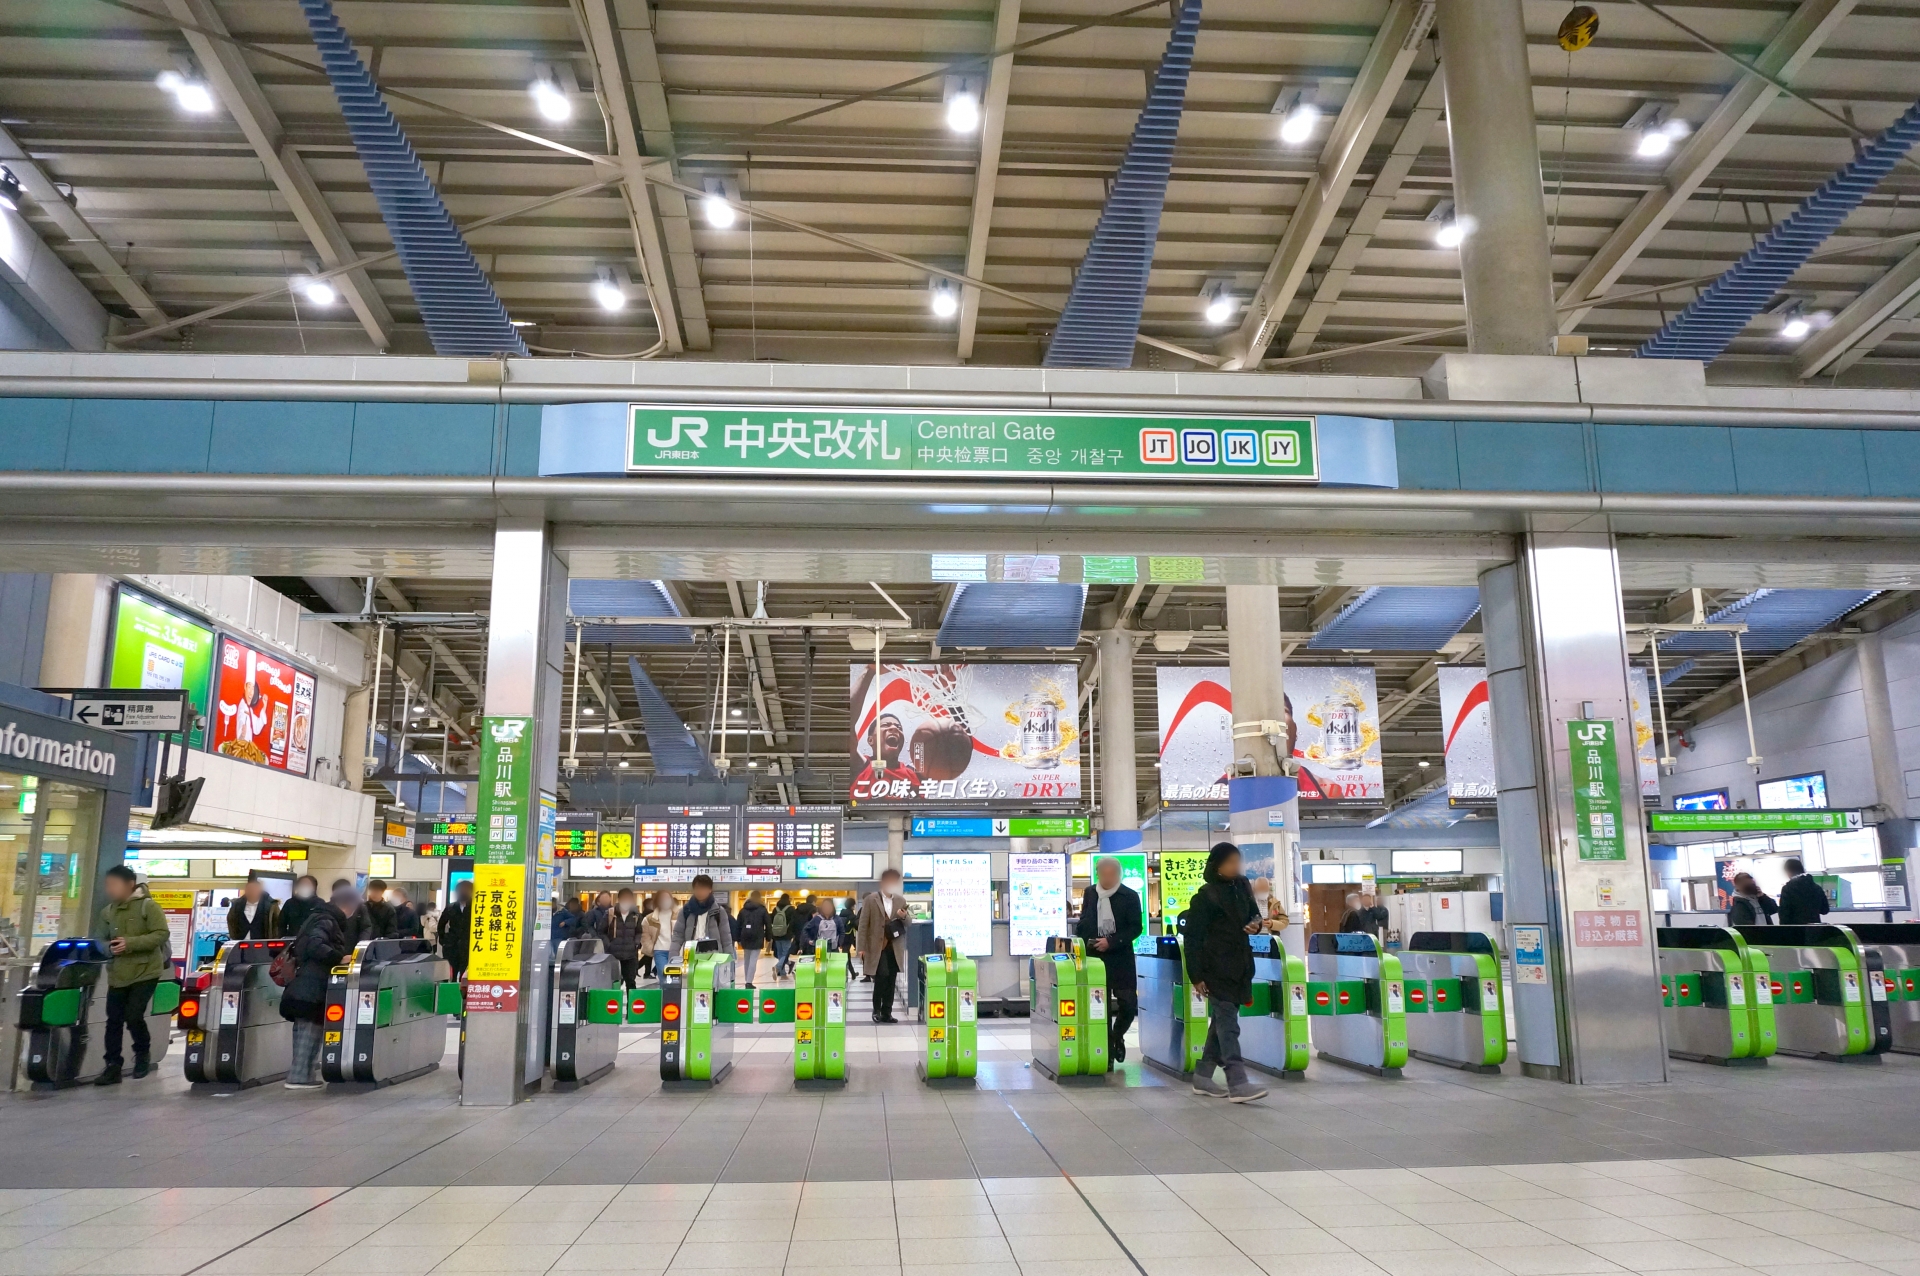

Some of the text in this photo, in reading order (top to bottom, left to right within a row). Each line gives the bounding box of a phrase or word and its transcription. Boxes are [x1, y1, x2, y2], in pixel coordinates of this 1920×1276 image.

[647, 416, 709, 448] JR
[724, 418, 901, 460] 中央改札
[917, 420, 1056, 441] Central Gate
[654, 450, 700, 460] JR東日本
[917, 445, 1008, 464] 中央检票口
[1149, 438, 1291, 456] JT JO JK JY
[1026, 447, 1124, 466] 중앙 개찰구
[127, 705, 154, 713] 精算機
[491, 720, 523, 738] JR
[1023, 719, 1056, 733] Asahi
[1326, 720, 1357, 734] Asahi
[1577, 724, 1607, 741] JR
[494, 746, 513, 798] 品川駅
[1587, 749, 1606, 797] 品川駅
[914, 820, 925, 834] 4
[1075, 820, 1085, 834] 3
[1836, 814, 1843, 828] 1
[472, 890, 487, 952] 行けません
[488, 890, 504, 952] 京急線には
[505, 890, 517, 959] この改札口から
[1579, 915, 1637, 927] 危険物品
[1580, 930, 1639, 942] 持込み厳禁
[930, 1003, 944, 1017] IC
[1061, 1002, 1075, 1015] IC
